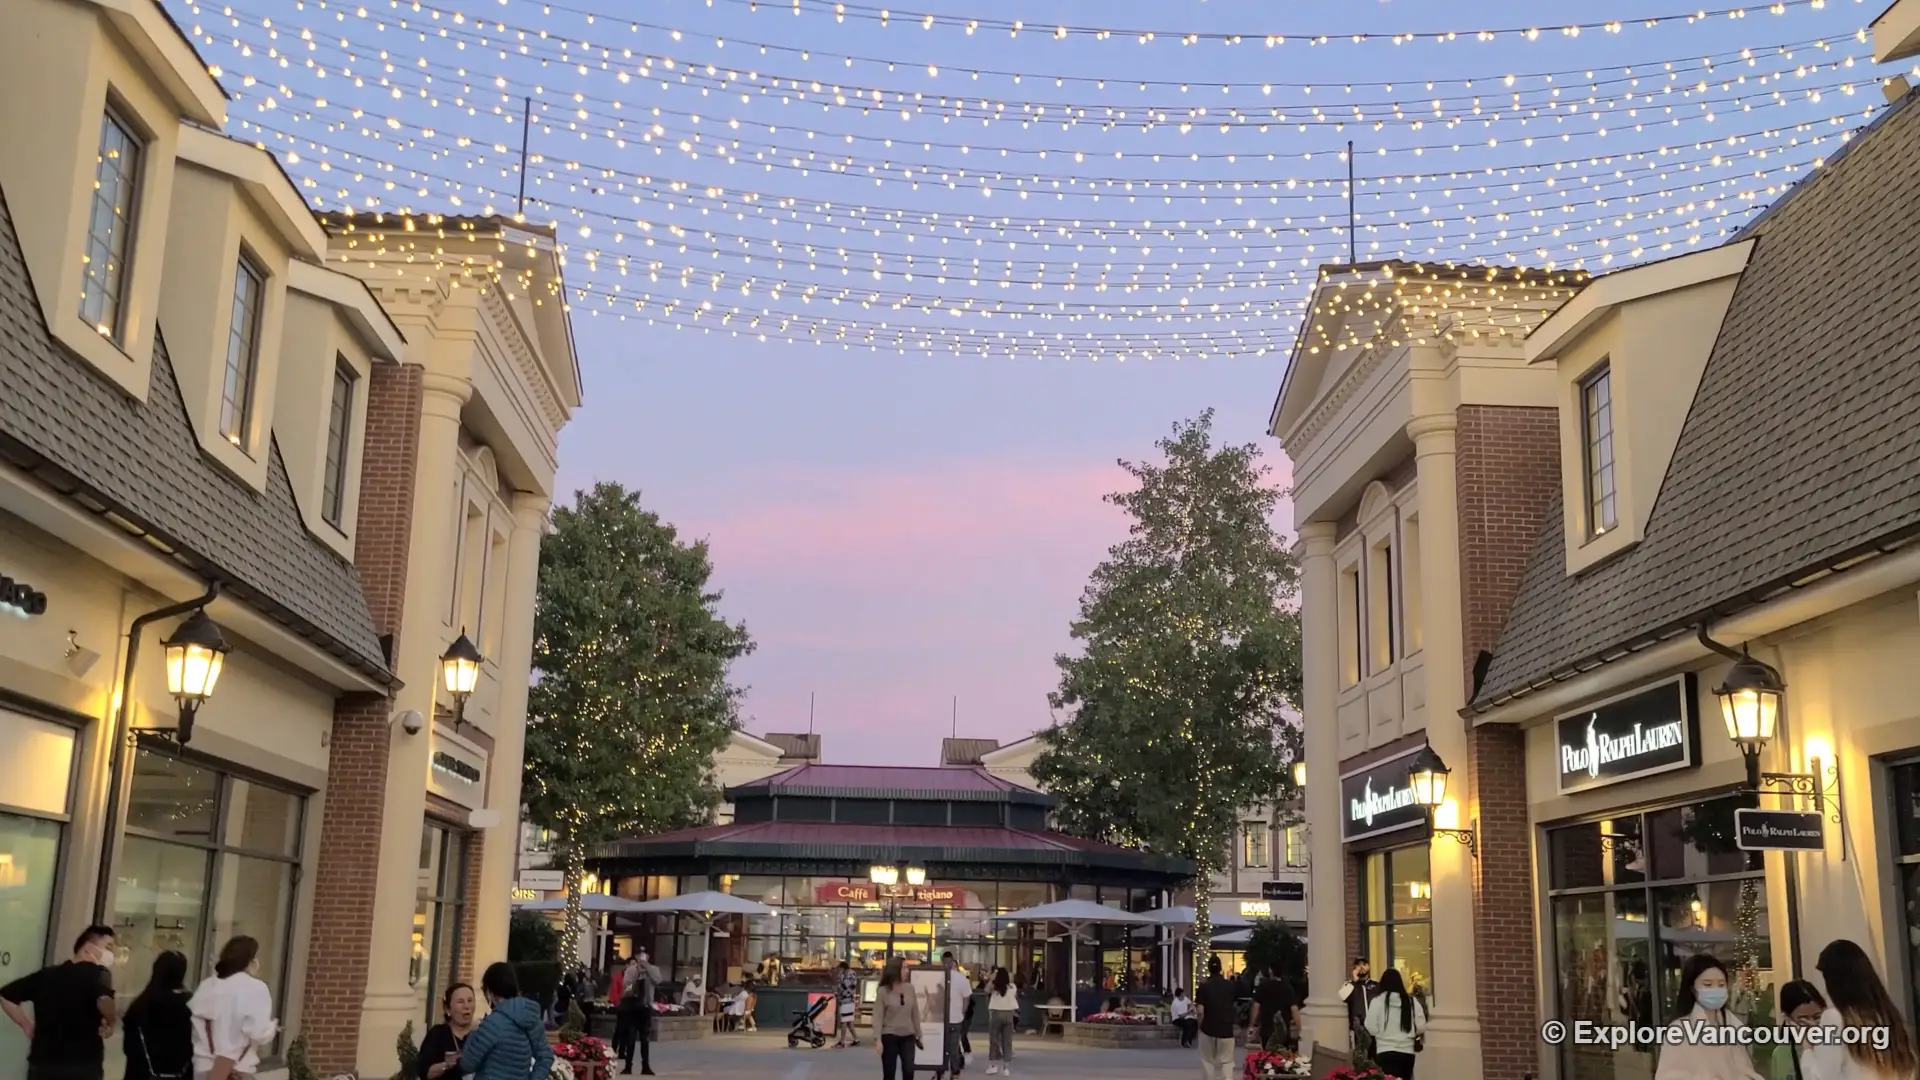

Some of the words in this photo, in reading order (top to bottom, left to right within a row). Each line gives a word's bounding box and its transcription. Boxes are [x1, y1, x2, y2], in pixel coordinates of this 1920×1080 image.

[1562, 744, 1589, 774] POLO
[1599, 733, 1636, 764] RALPH
[1634, 721, 1682, 754] LAUREN
[1742, 826, 1762, 835] POLO
